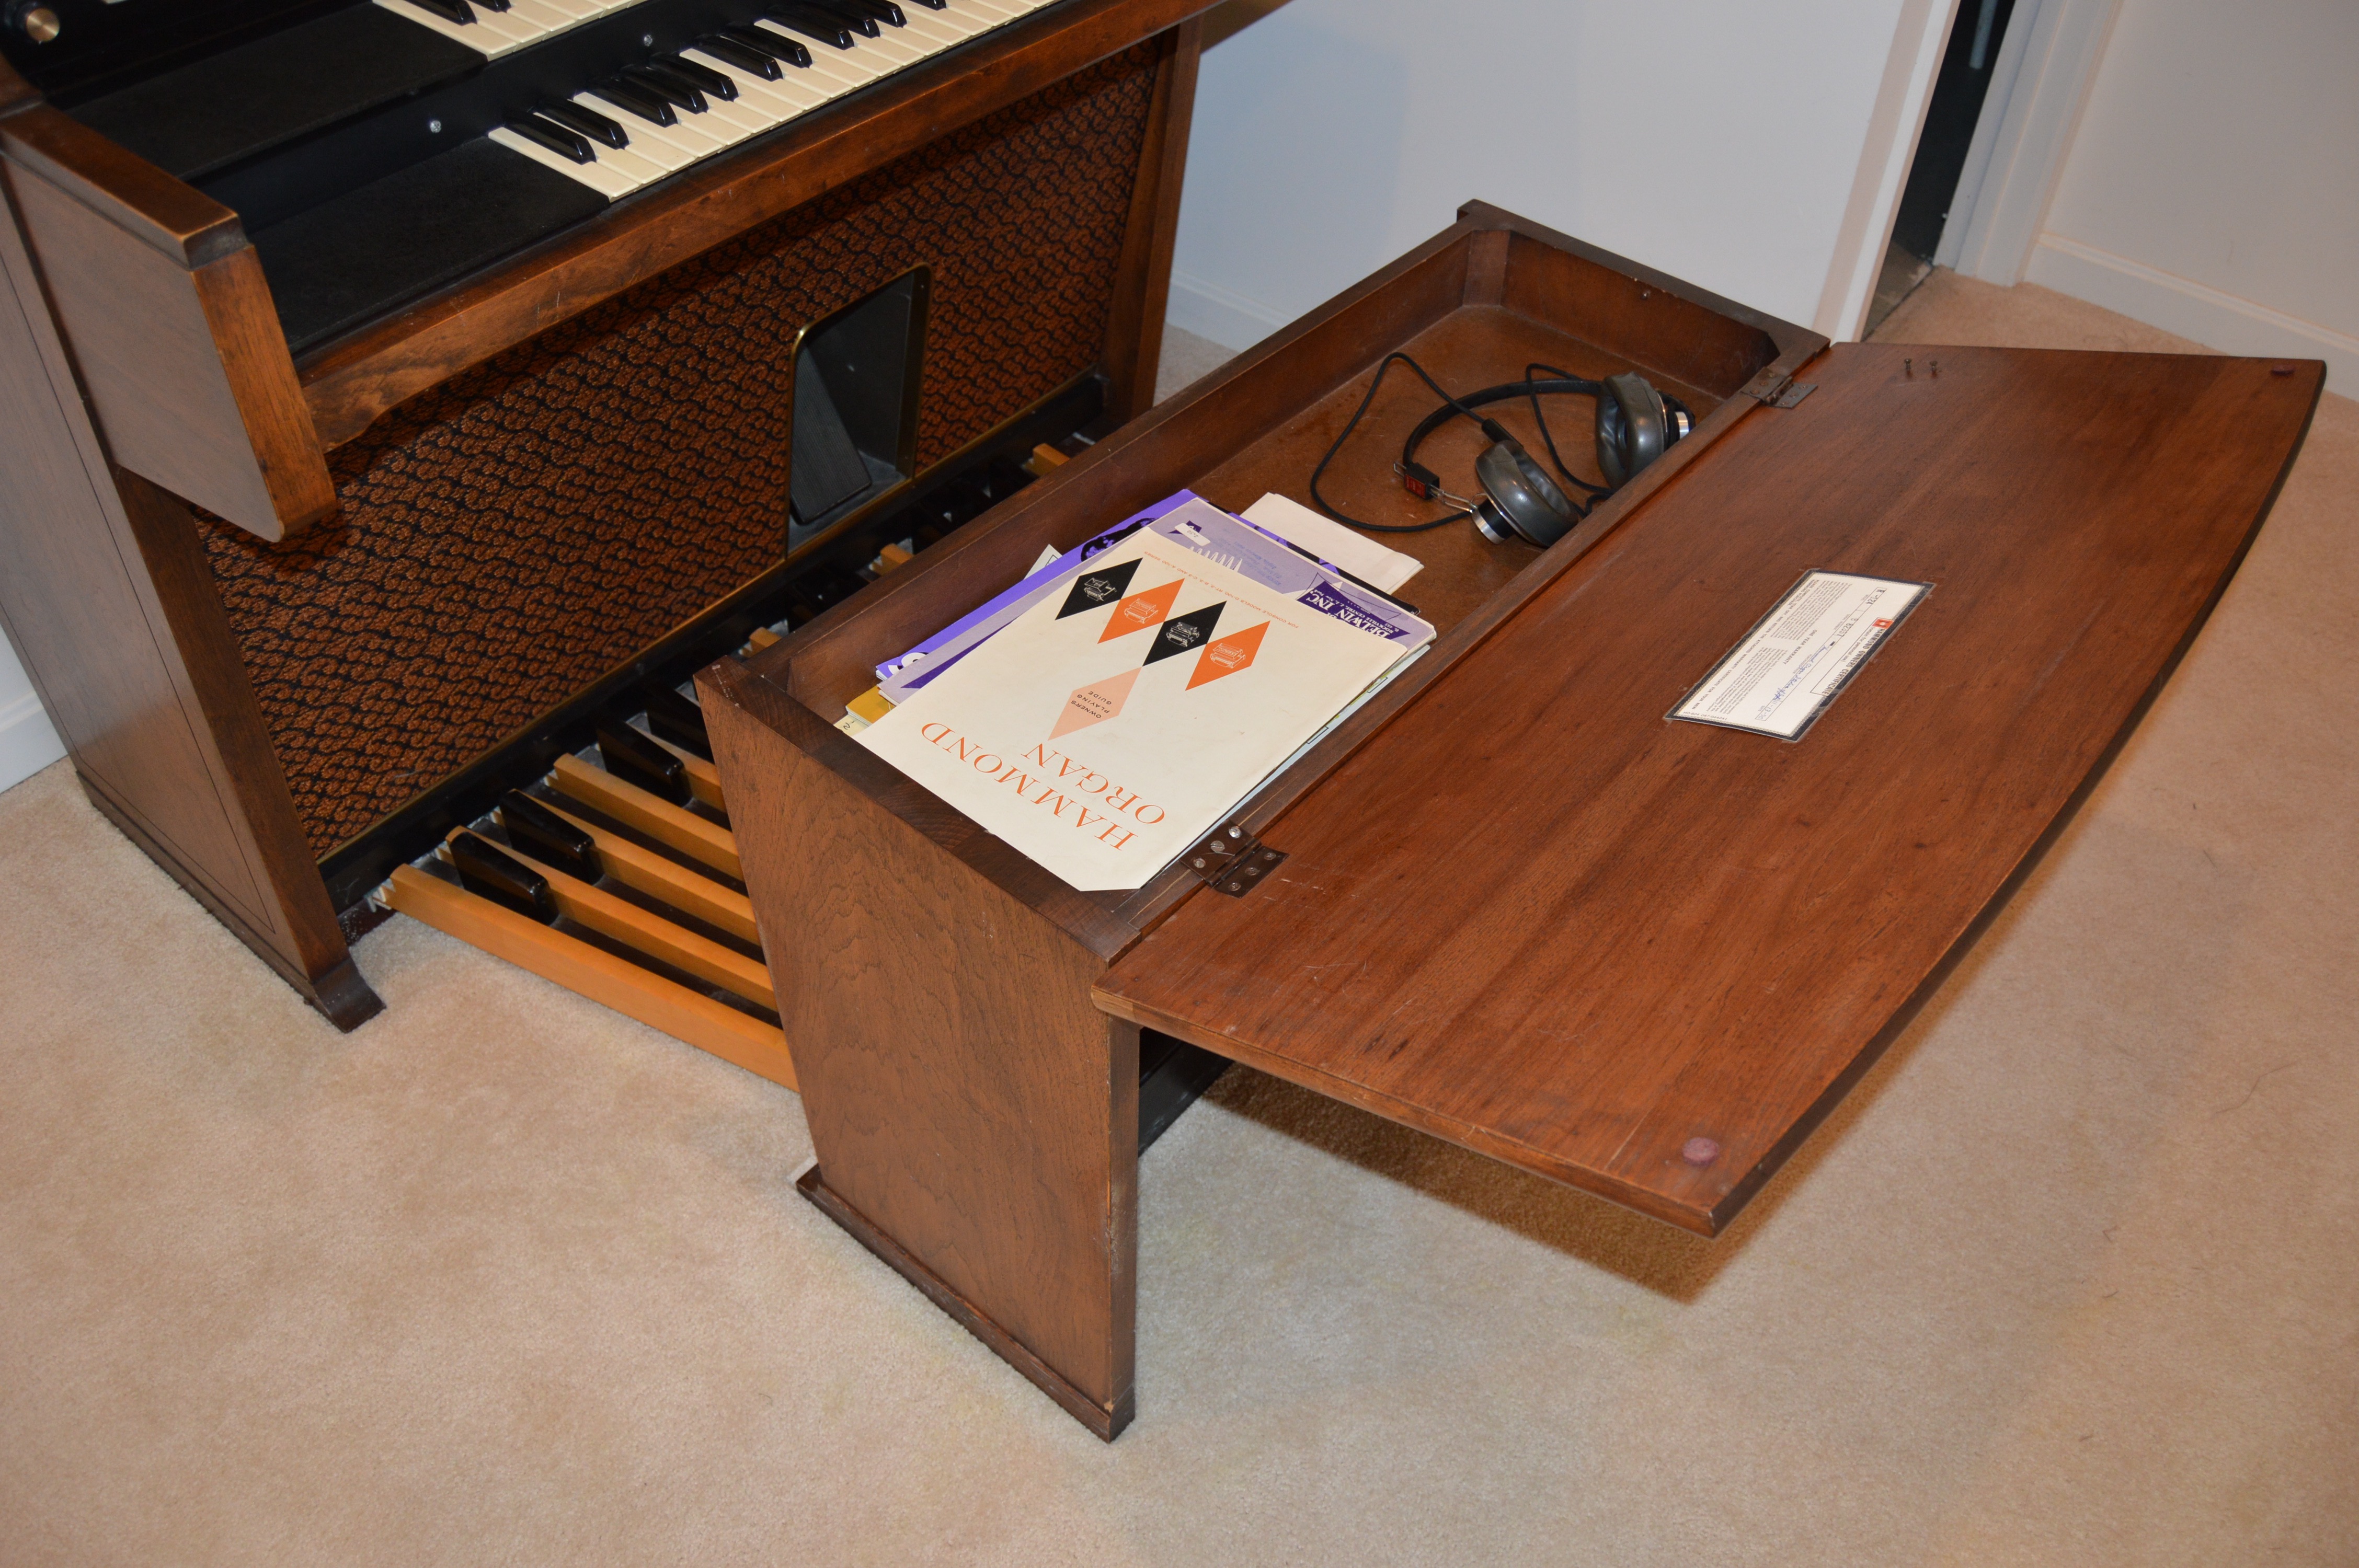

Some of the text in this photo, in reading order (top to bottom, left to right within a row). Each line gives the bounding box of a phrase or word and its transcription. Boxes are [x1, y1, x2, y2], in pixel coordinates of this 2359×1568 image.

[1144, 551, 1161, 560] SERIES
[1241, 600, 1261, 610] MODELS
[1262, 610, 1286, 622] CONSOLE
[1334, 608, 1391, 638] BELWIN
[1366, 616, 1394, 634] ROCKVILLE
[1766, 623, 1777, 632] RETURN
[1863, 629, 1885, 649] HAMMOND
[1783, 647, 1802, 664] WARRANTY
[1848, 642, 1861, 655] personal
[1732, 654, 1747, 668] WARRANTY
[1846, 651, 1865, 667] OWNERS
[1714, 670, 1732, 686] CERTIFICATE
[1822, 669, 1849, 695] CERTIFICATE
[1077, 695, 1110, 713] PLAYING
[1088, 691, 1112, 705] GUIDE
[1071, 700, 1101, 718] OWNER'S
[922, 723, 1137, 849] HAMMOND
[1021, 744, 1164, 824] ORGAN
